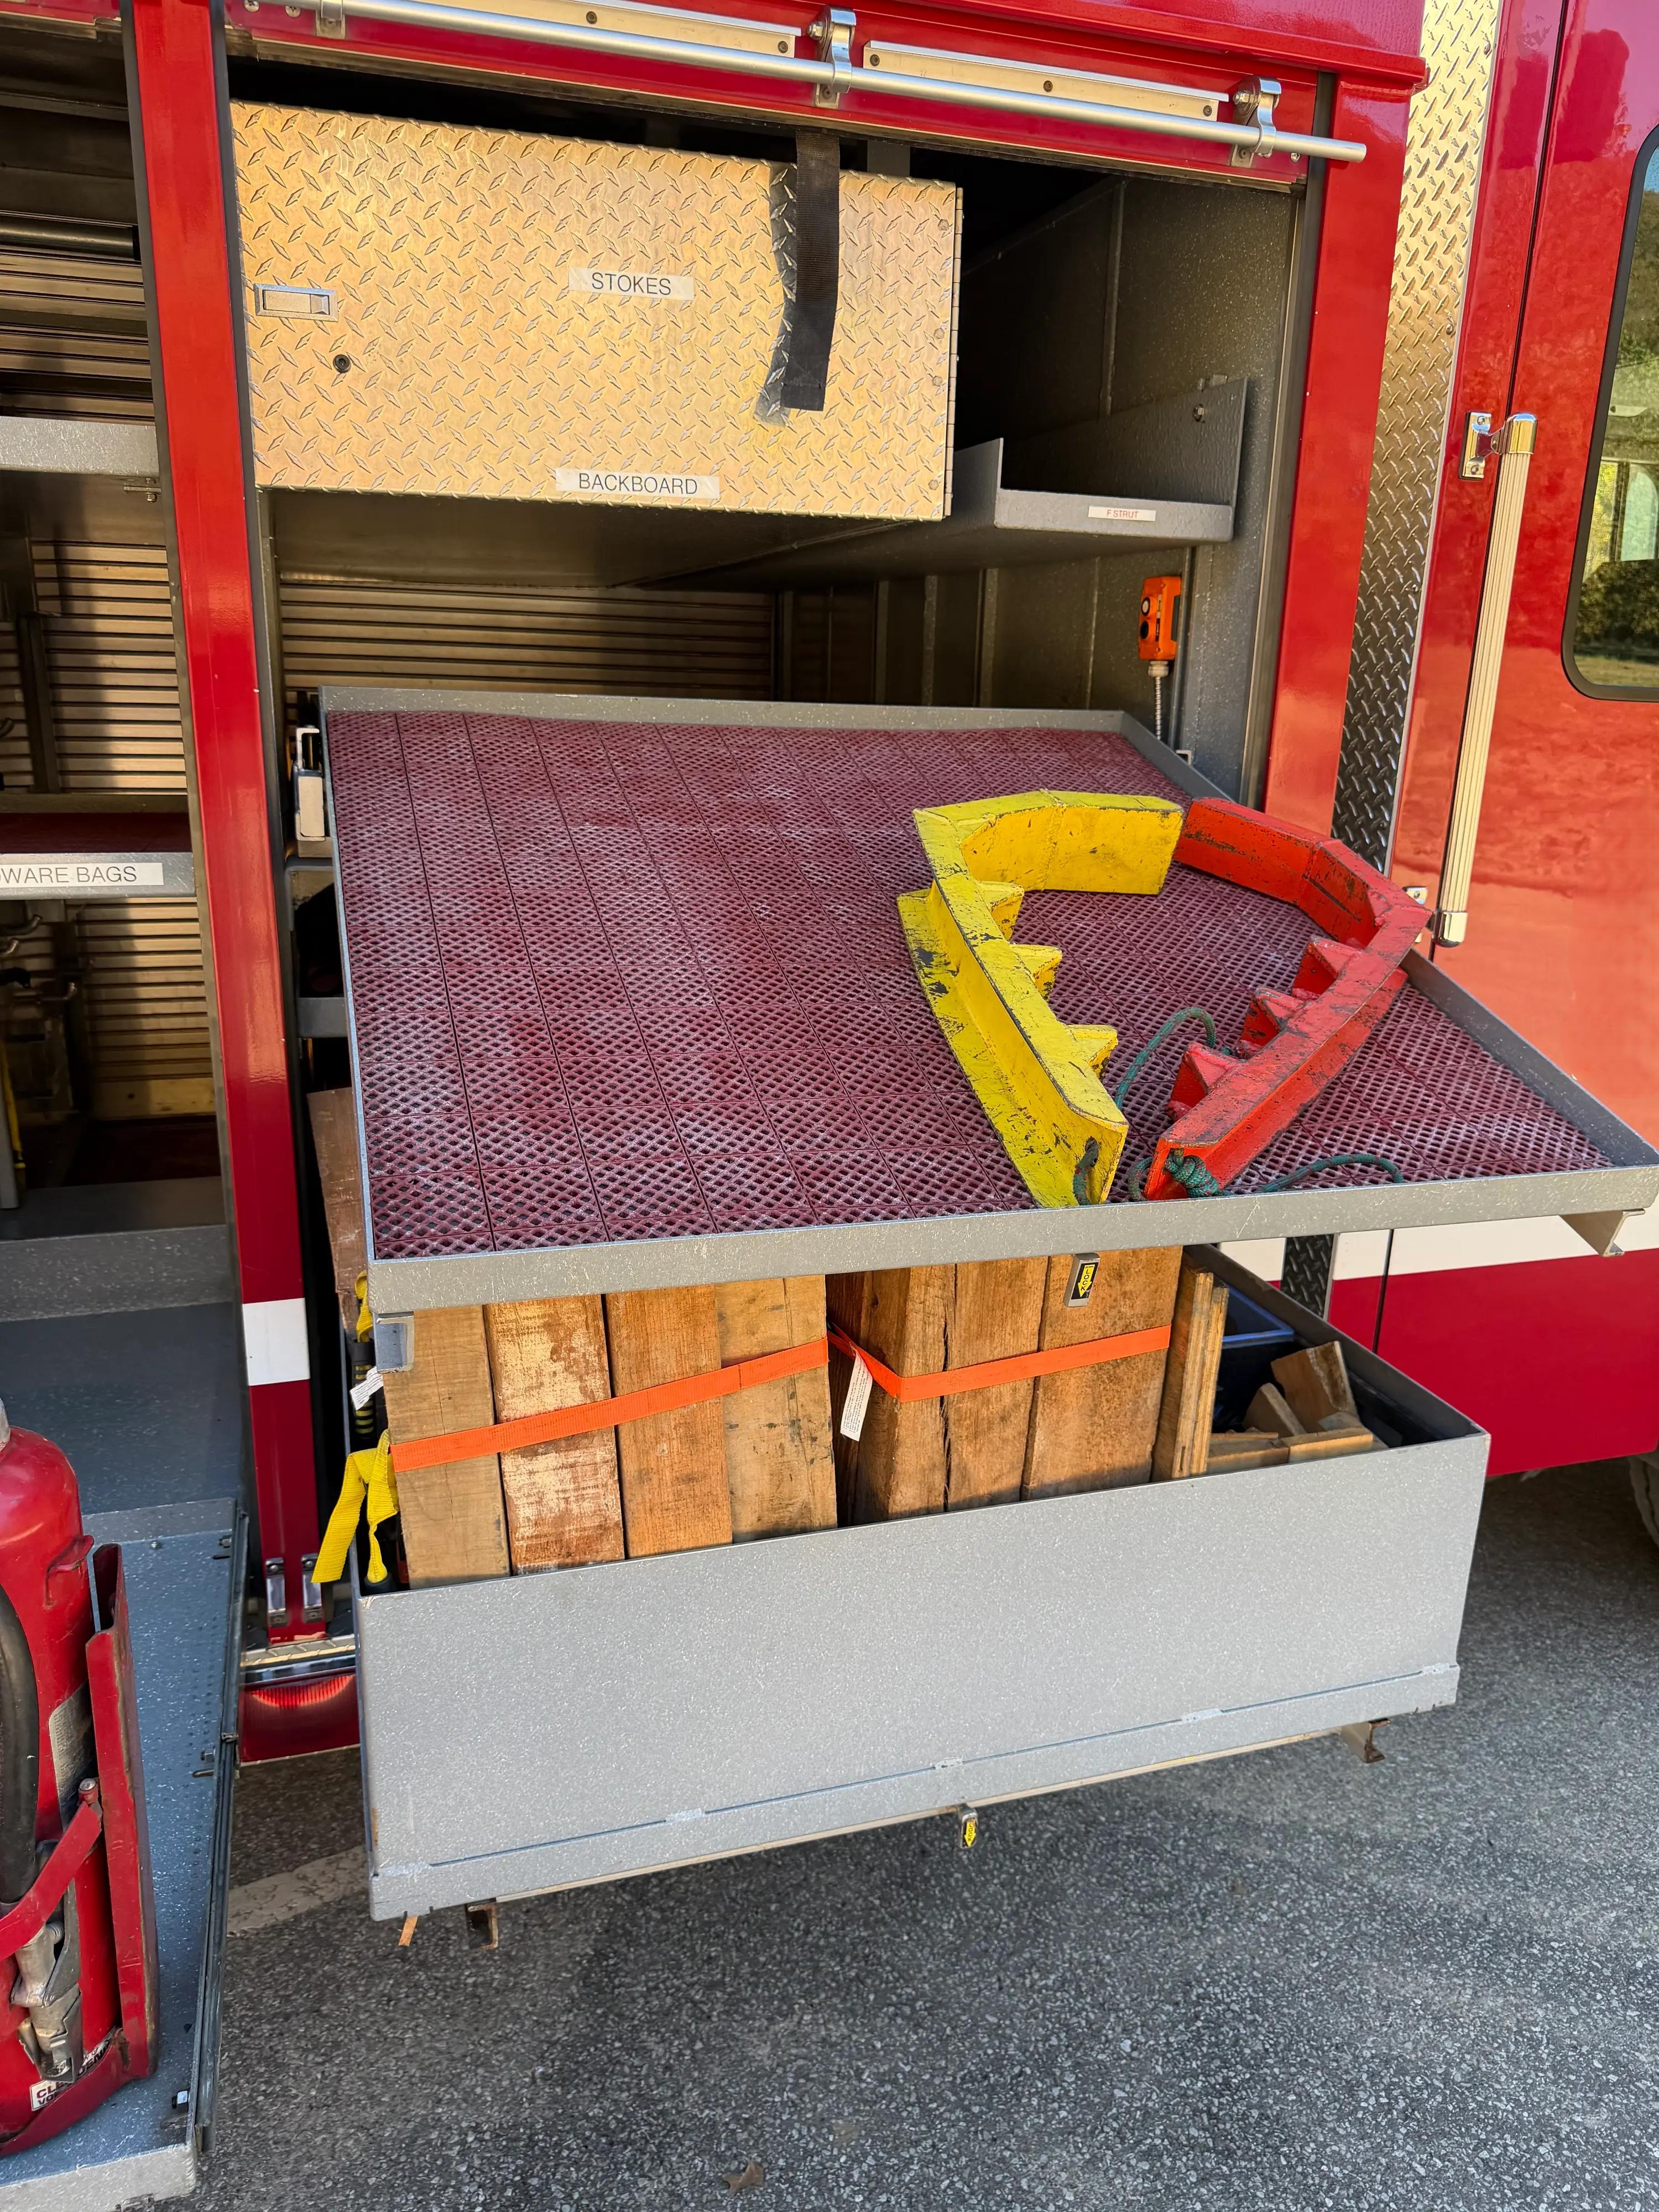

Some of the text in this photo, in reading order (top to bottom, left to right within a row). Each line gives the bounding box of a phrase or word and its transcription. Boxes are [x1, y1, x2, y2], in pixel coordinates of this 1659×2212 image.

[592, 272, 671, 296] STOKES
[578, 472, 698, 495] BACKBOARD
[1113, 510, 1139, 519] STRUT
[0, 865, 137, 884] WARE BAGS
[1081, 1269, 1090, 1291] LOCK
